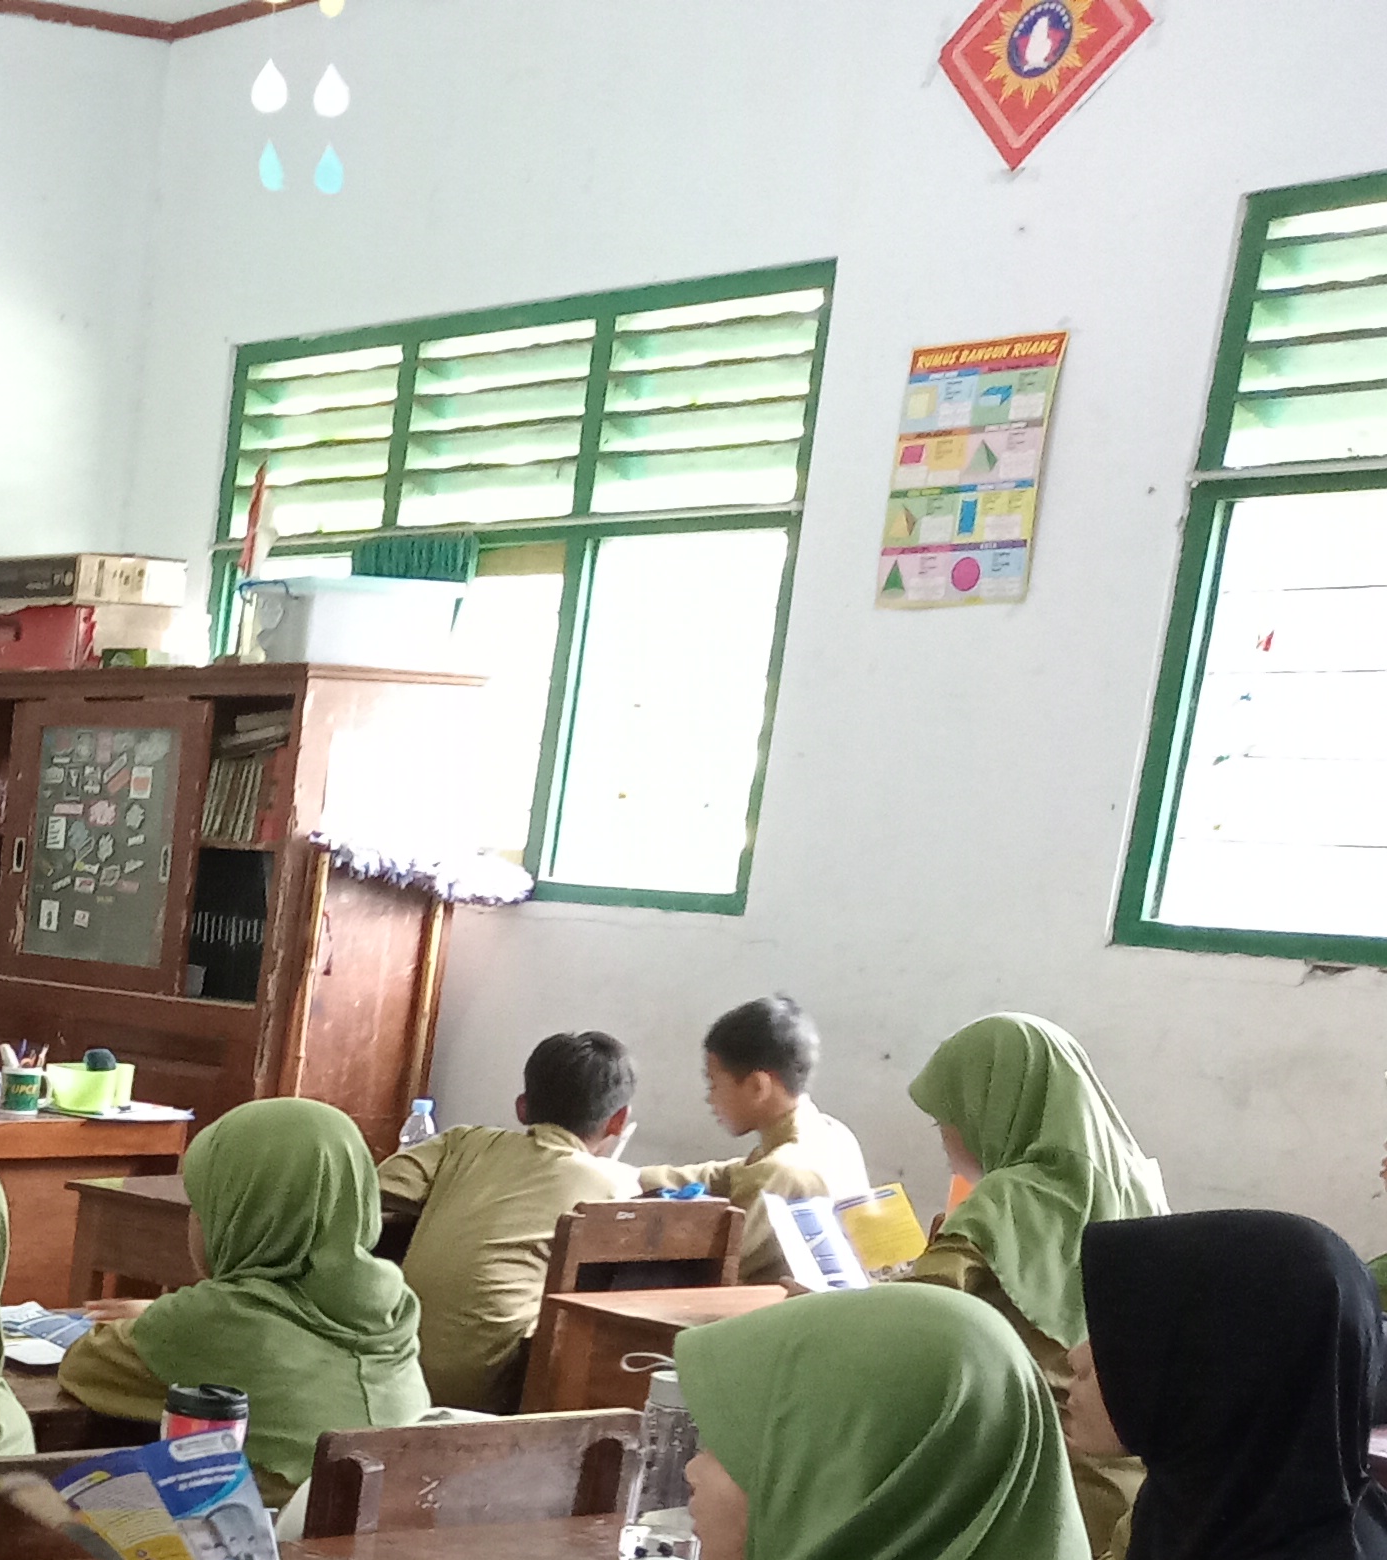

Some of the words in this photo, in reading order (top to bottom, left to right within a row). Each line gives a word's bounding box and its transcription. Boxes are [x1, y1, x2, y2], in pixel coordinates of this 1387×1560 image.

[916, 350, 958, 369] RUMUS
[959, 345, 1008, 364] BANGUN
[1010, 339, 1059, 358] RUANG
